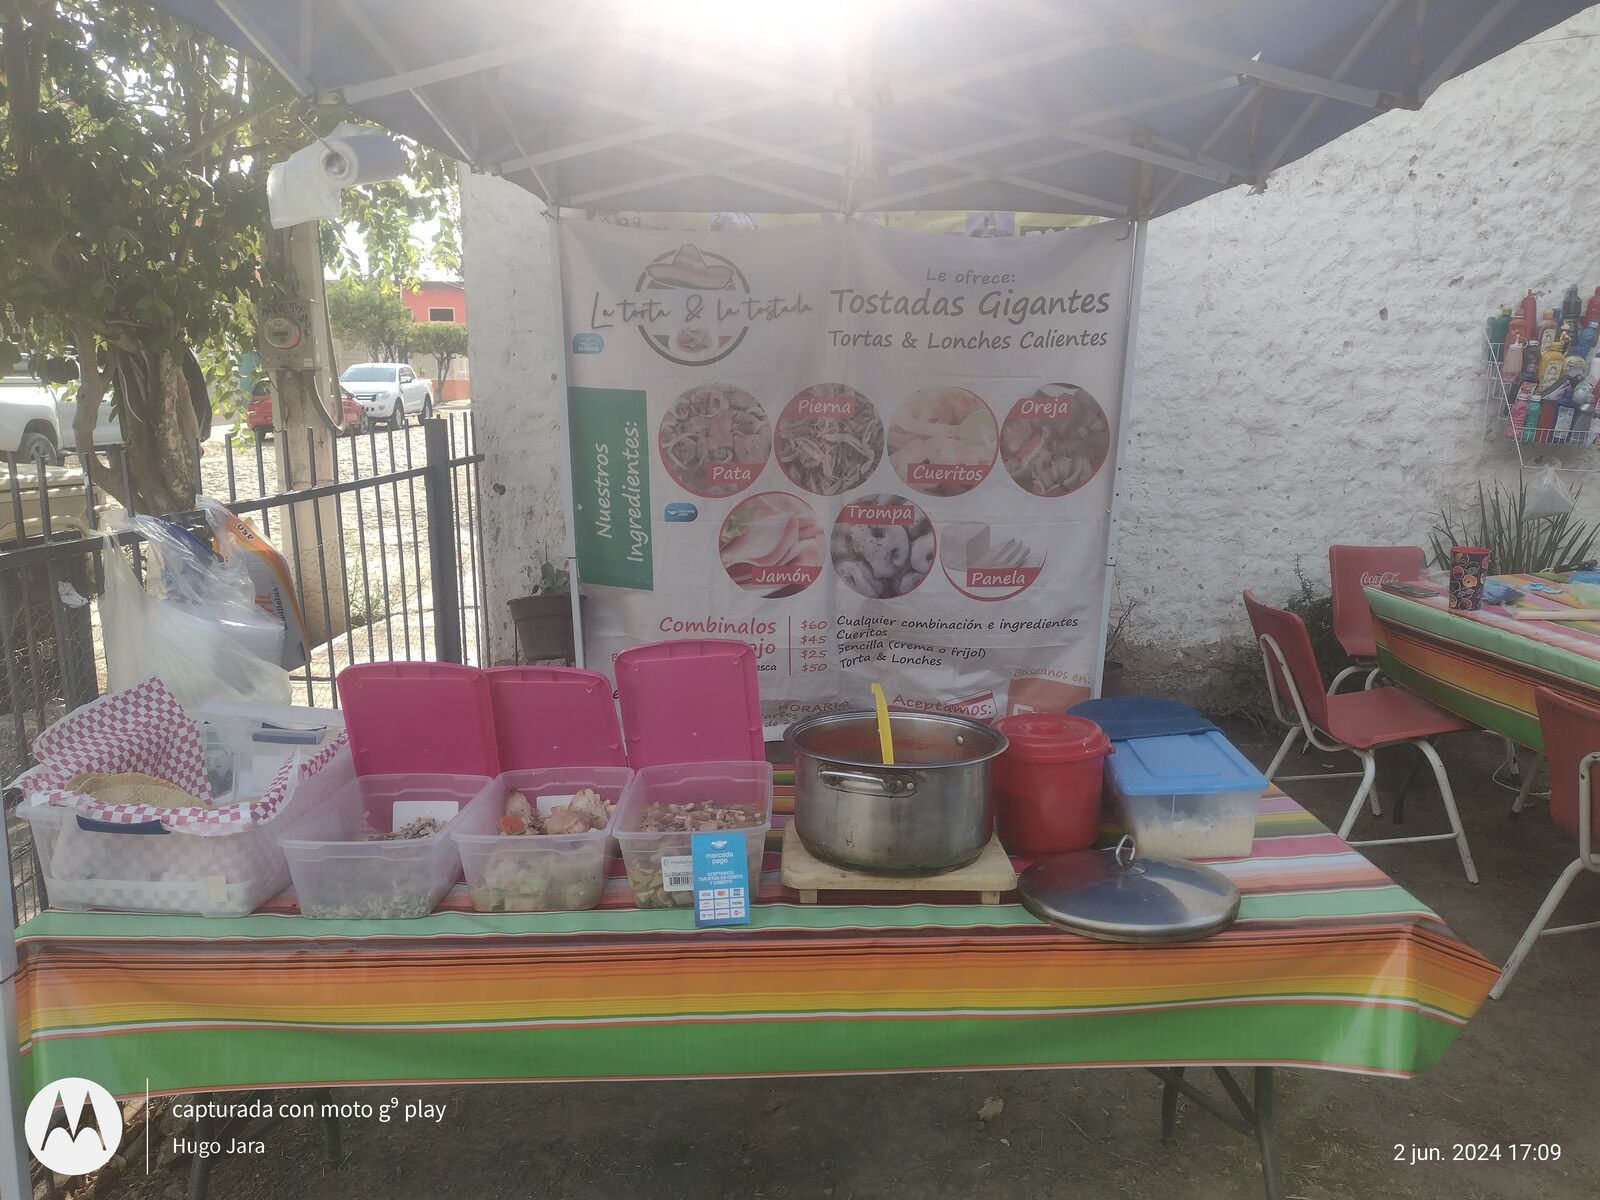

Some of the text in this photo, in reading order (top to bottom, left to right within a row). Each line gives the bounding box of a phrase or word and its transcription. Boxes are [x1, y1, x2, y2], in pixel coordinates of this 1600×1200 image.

[926, 268, 1016, 284] Le ofrece:
[591, 291, 814, 329] La torta & la tostada
[831, 287, 1111, 325] Tostadas Gigantes
[828, 329, 1107, 350] Tortas & Lonches Calientes
[798, 399, 851, 414] Pierna
[1020, 399, 1068, 419] Oreja
[713, 465, 752, 481] Pata
[913, 464, 983, 482] Cueritos
[594, 442, 613, 539] Nuestros
[622, 420, 649, 562] Ingredientes:
[847, 505, 913, 524] Trompa
[756, 568, 812, 584] Jamón
[971, 570, 1025, 586] Panela
[659, 616, 777, 635] Combinalos
[801, 619, 828, 631] $60
[836, 615, 1079, 633] Cualquier combinación e ingredientes
[801, 634, 828, 645] $45
[836, 629, 888, 640] Cueritos
[801, 648, 828, 660] $25
[837, 639, 884, 654] Sencilla
[889, 640, 934, 653] (crema
[951, 647, 987, 660] frijol)
[801, 662, 828, 673] $50
[840, 652, 942, 669] Torta & Lonches
[892, 694, 993, 717] Aceptamos:
[761, 711, 798, 720] artes
[705, 851, 734, 859] mercado
[711, 857, 729, 865] pago
